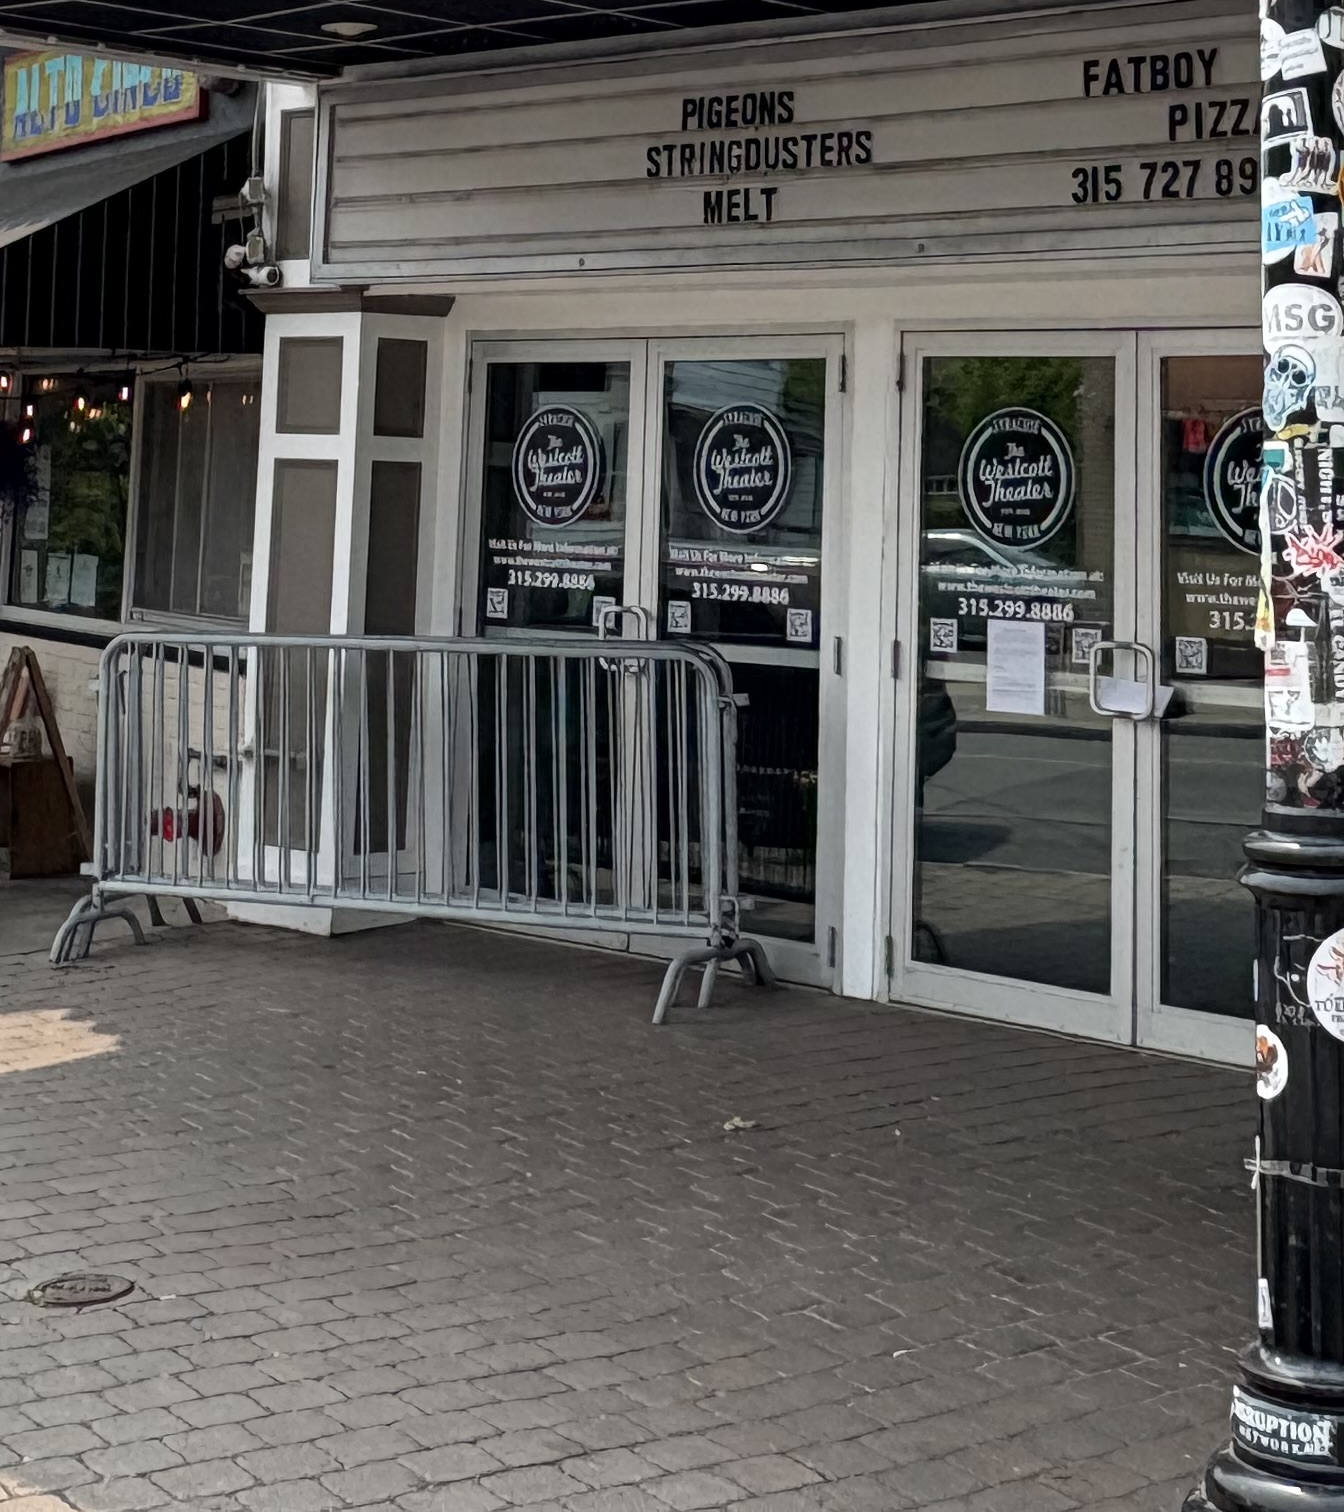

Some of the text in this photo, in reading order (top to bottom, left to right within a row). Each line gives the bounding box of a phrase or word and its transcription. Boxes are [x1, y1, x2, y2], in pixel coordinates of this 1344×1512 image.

[1083, 48, 1218, 98] FATBOY
[681, 91, 796, 132] PIGEONS
[1169, 98, 1261, 142] PIZZ
[646, 130, 873, 179] STRINGDUSTERS
[1071, 157, 1258, 204] 315 727 89
[703, 188, 779, 225] MELT
[979, 454, 1054, 481] Westcott
[1004, 442, 1025, 460] The
[713, 467, 773, 495] Theater
[982, 478, 1054, 508] Theater
[1223, 573, 1244, 587] For
[958, 597, 1075, 621] 315.299.8886
